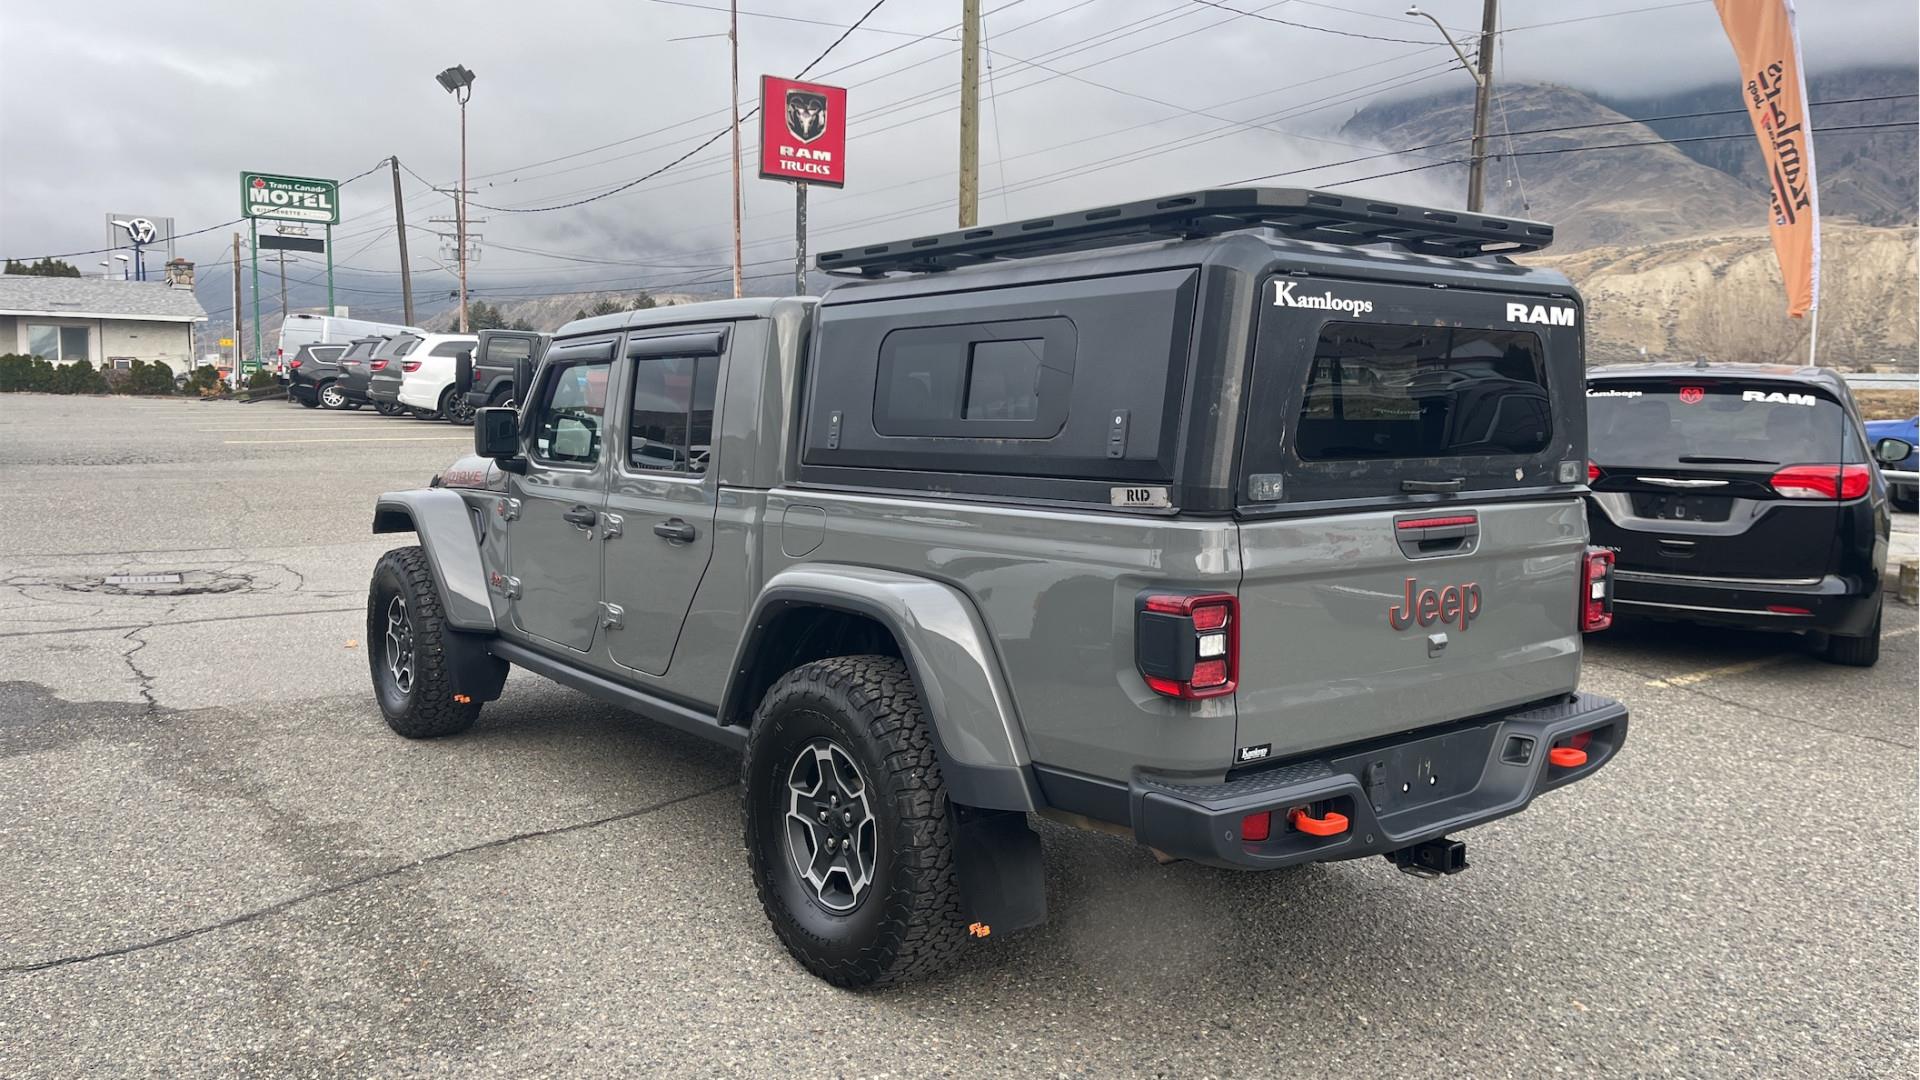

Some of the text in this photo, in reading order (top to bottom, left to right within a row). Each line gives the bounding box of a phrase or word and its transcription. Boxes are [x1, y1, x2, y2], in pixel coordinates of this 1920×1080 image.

[780, 145, 832, 162] RAM
[780, 160, 831, 175] TRUCKS
[268, 182, 326, 193] Trans Canada
[249, 187, 332, 209] MOTEL
[1273, 280, 1373, 318] Kamloops
[1506, 302, 1575, 327] RAM
[1742, 390, 1816, 407] RAM
[1126, 488, 1151, 502] RLD
[1388, 577, 1482, 632] Jeep
